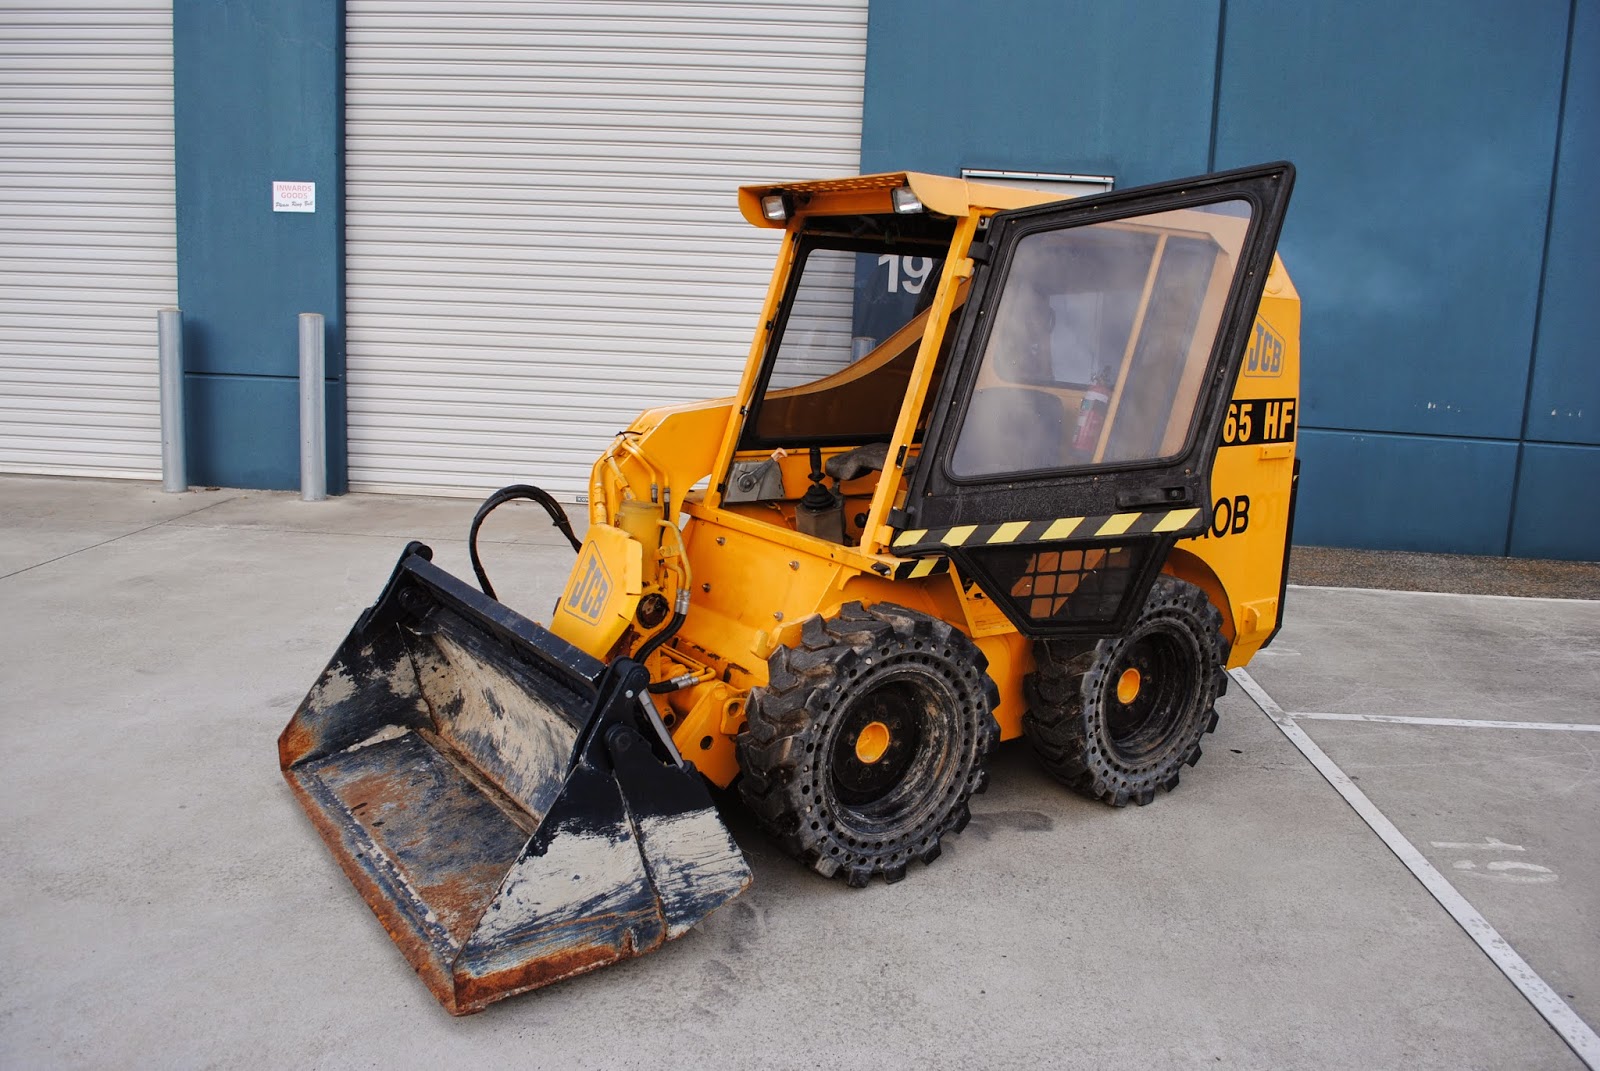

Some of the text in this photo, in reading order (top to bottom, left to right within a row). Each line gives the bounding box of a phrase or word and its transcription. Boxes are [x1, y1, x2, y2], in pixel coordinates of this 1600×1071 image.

[277, 184, 312, 192] INWARDS
[878, 253, 933, 295] 19
[1247, 322, 1283, 373] JCB
[1222, 401, 1295, 443] 65 HF
[1203, 495, 1250, 540] OB
[568, 553, 608, 619] JCB
